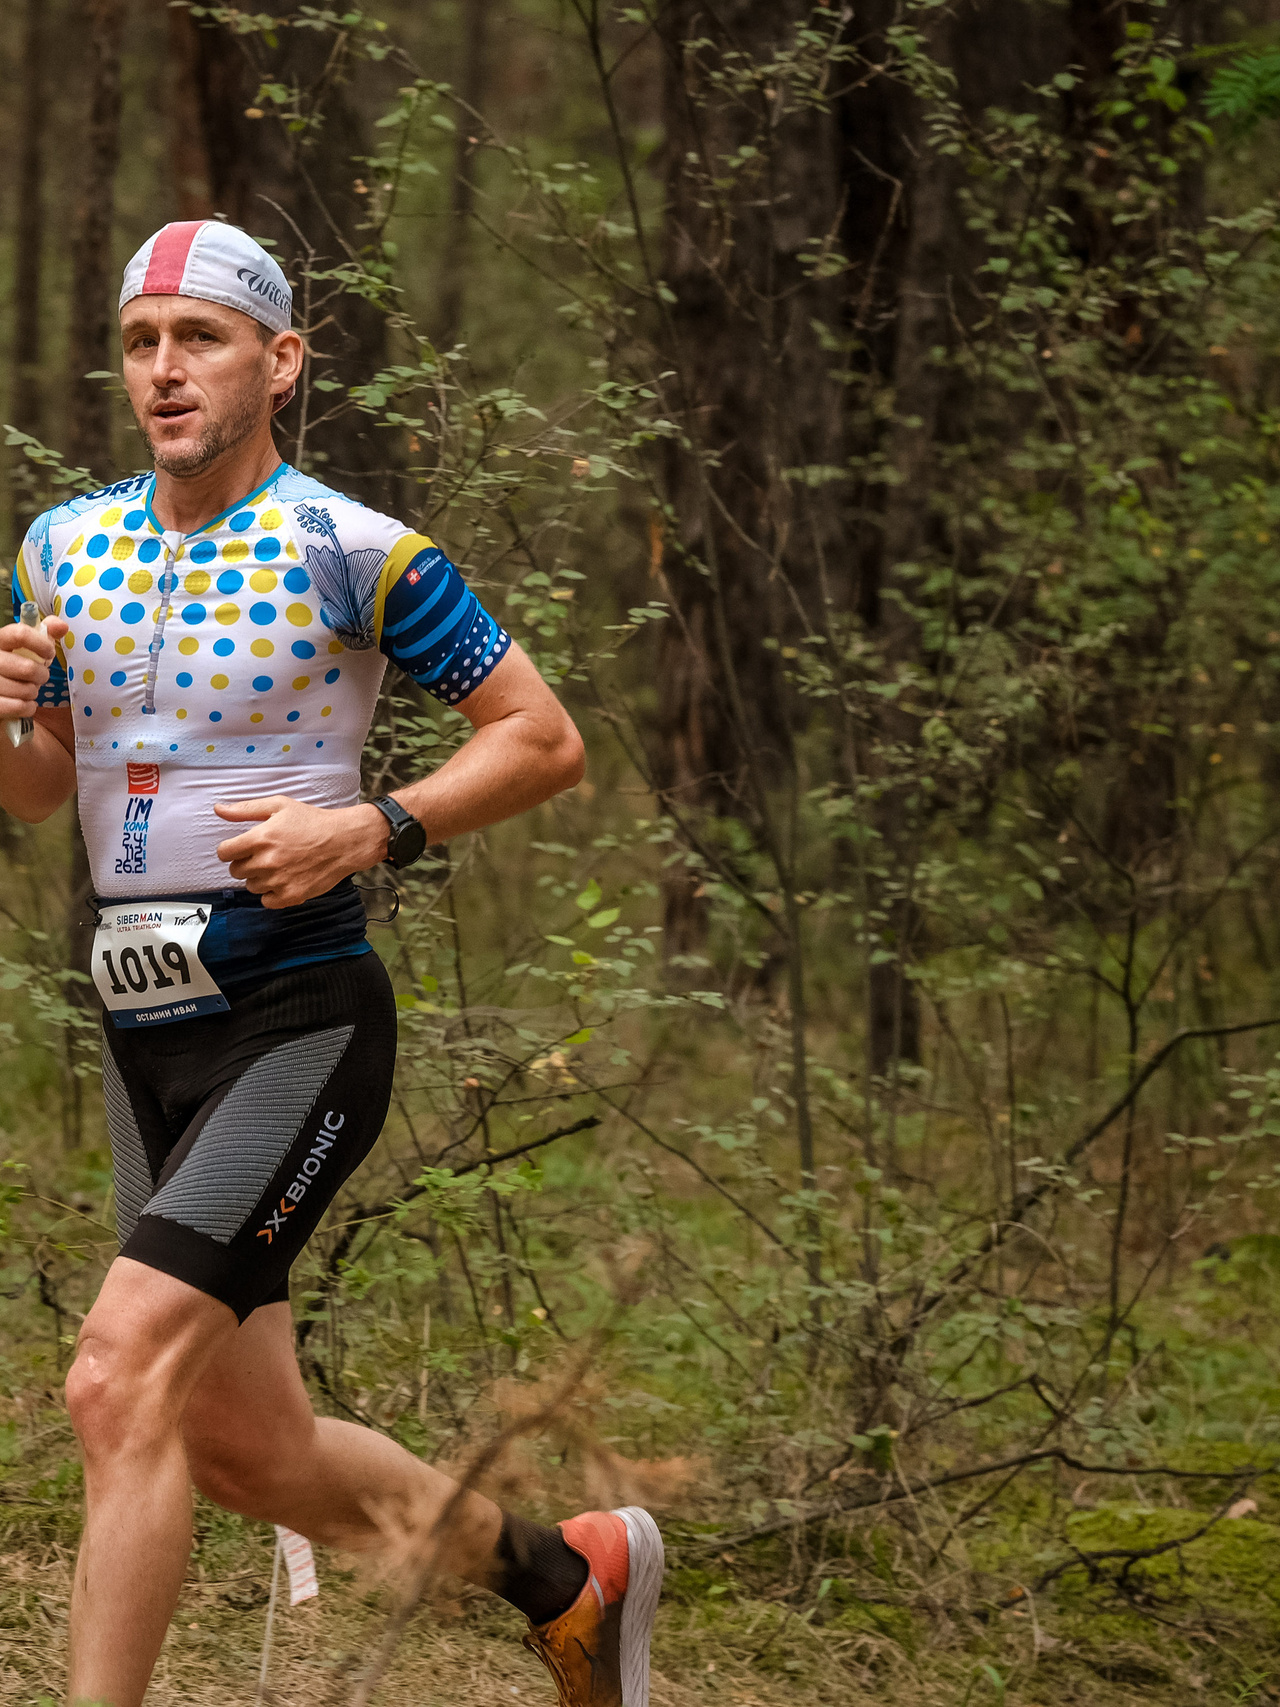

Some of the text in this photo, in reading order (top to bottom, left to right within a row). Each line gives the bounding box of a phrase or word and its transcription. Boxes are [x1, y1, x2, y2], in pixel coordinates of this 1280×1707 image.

[125, 797, 154, 822] I'M
[123, 821, 149, 833] KONA
[114, 858, 144, 874] 26.2
[116, 912, 163, 926] SIBERMAN
[132, 923, 162, 932] TRIATHLON
[102, 941, 191, 995] 1019
[135, 1003, 198, 1022] ОСТАНИН ИВАН
